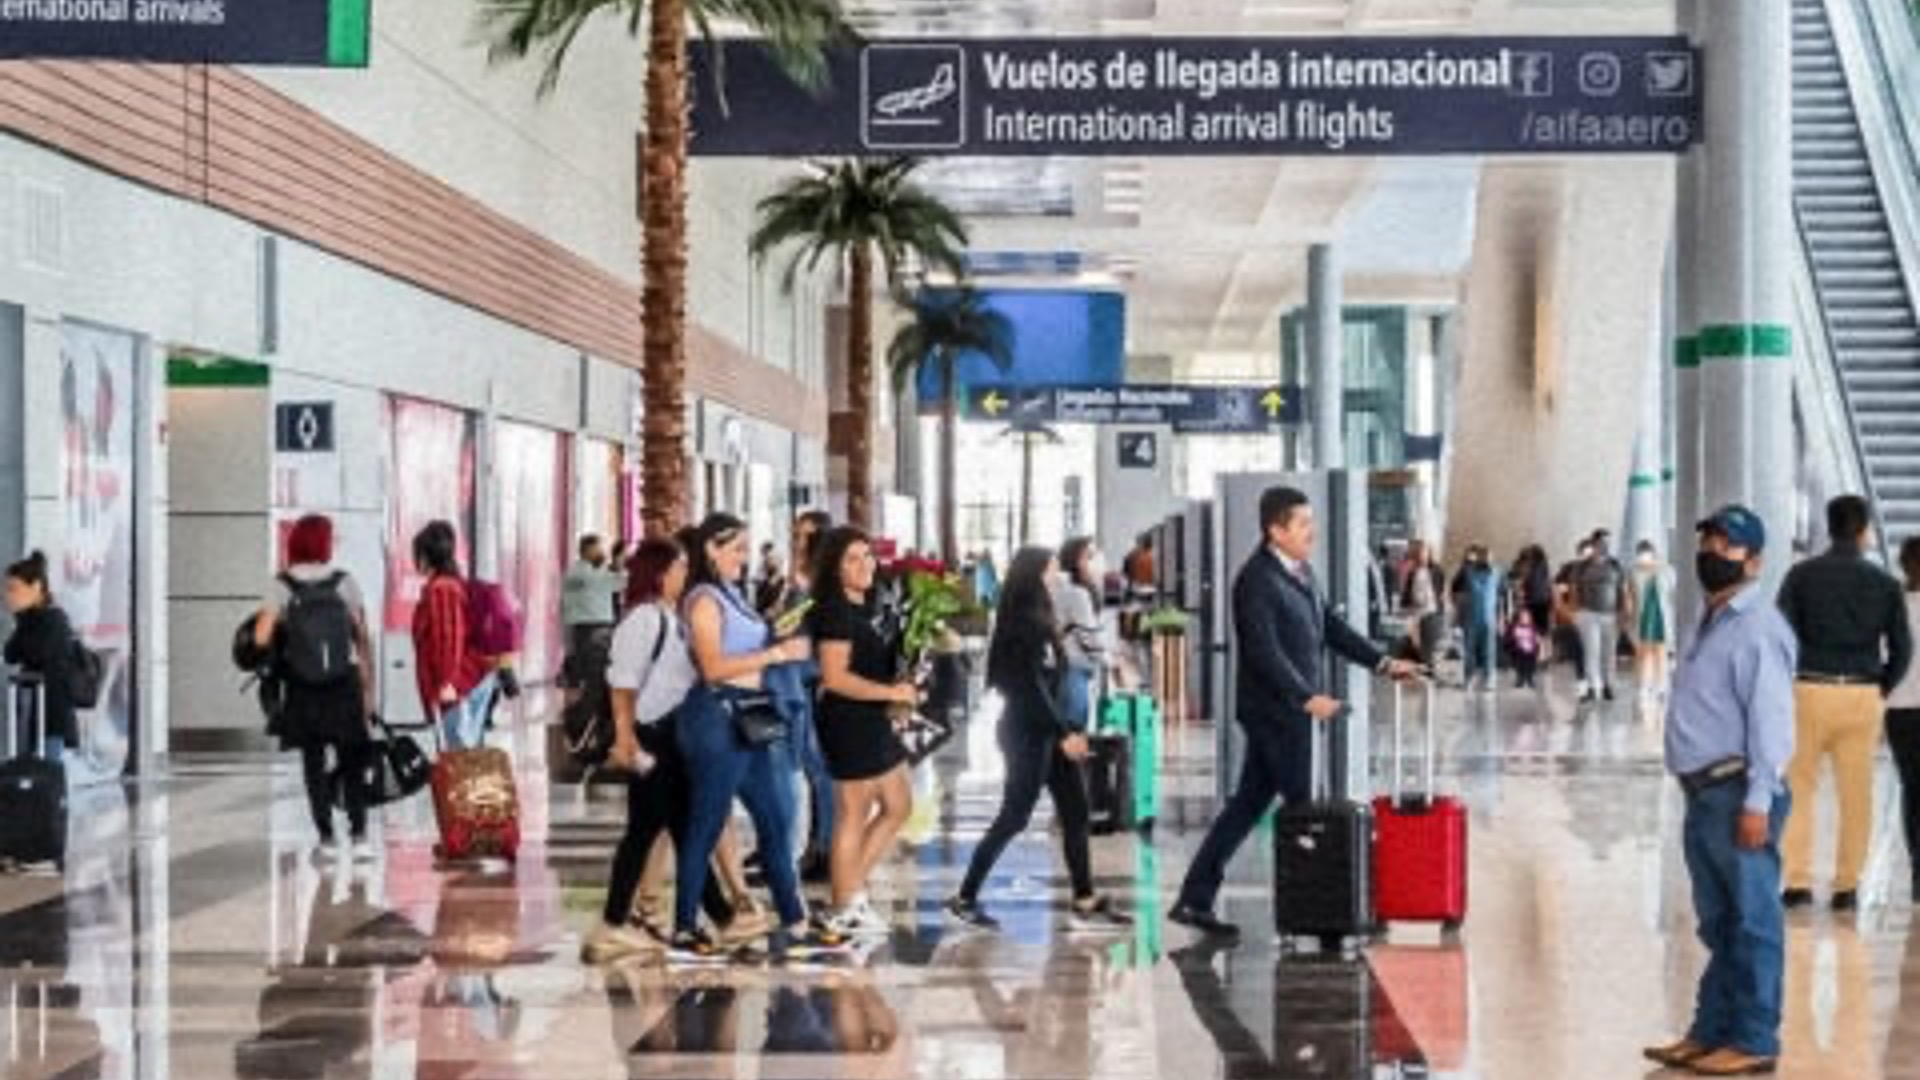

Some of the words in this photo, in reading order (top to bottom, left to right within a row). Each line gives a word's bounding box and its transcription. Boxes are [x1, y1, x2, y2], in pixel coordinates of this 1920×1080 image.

[983, 50, 1098, 90] Vuelos
[1105, 50, 1147, 89] de
[1155, 50, 1281, 98] llegada
[1289, 48, 1511, 88] internacional
[984, 102, 1184, 141] International
[1191, 103, 1288, 140] arrival
[1297, 102, 1394, 149] flights
